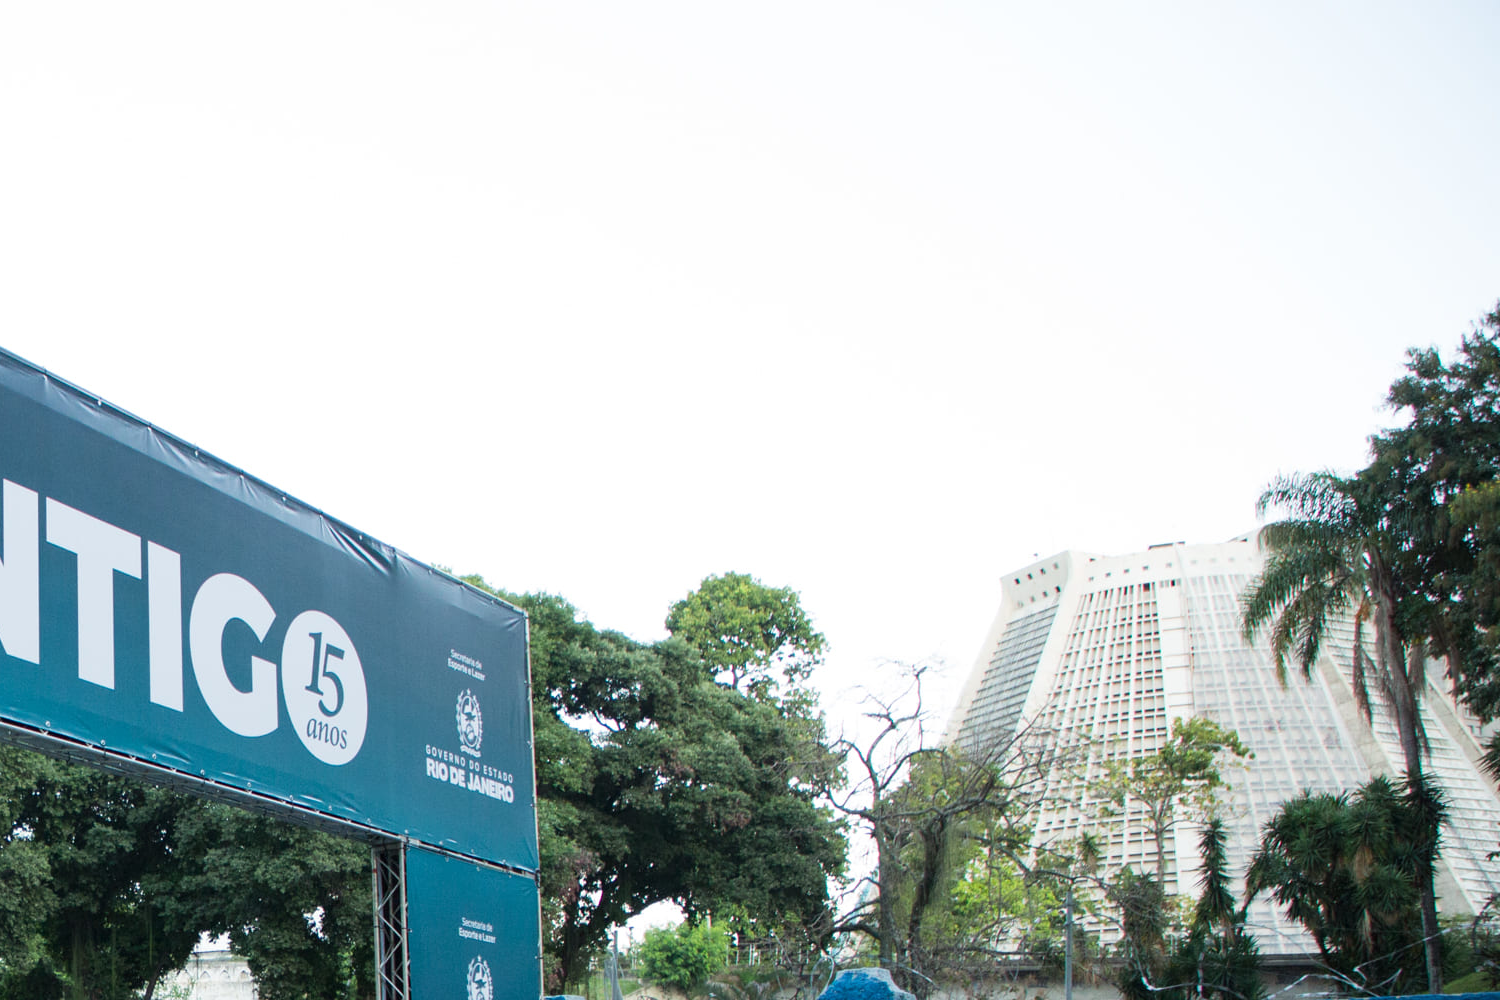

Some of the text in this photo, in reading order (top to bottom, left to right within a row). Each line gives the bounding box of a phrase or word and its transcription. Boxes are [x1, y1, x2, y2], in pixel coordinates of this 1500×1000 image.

[304, 631, 345, 718] 15
[306, 718, 348, 750] anos
[425, 744, 466, 768] GOVERNO
[469, 761, 480, 772] DO
[483, 765, 514, 784] ESTADO
[425, 757, 514, 804] RIO DE JANEIRO
